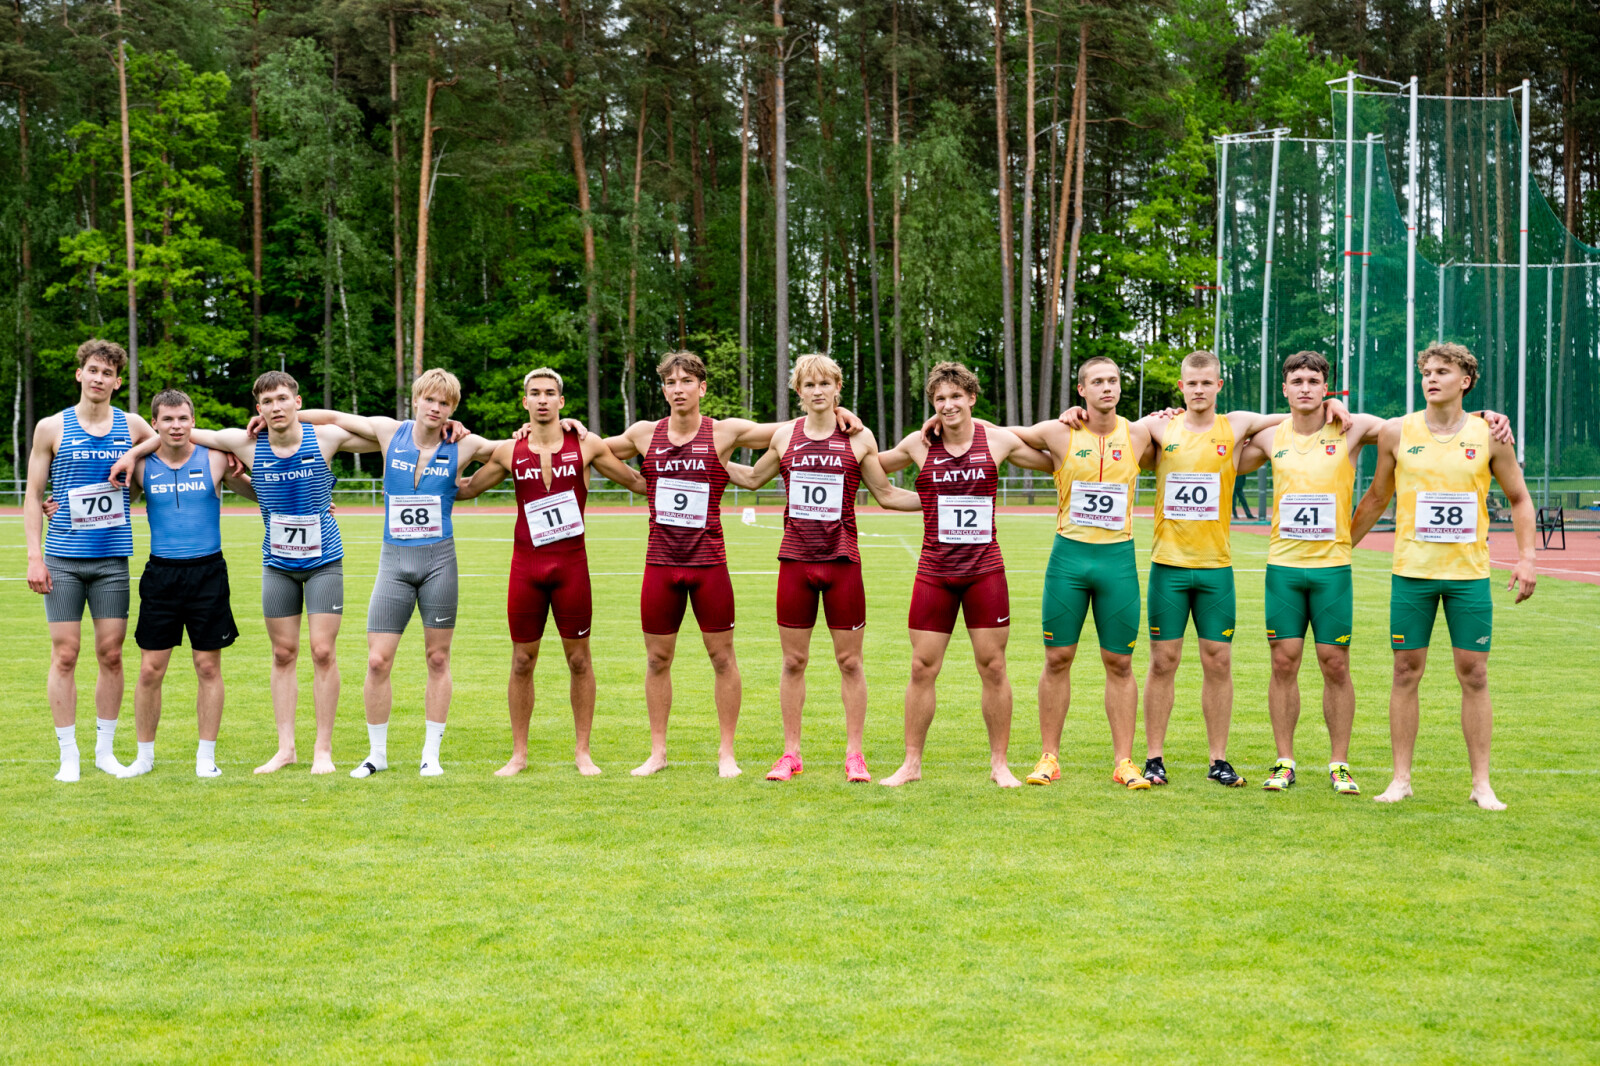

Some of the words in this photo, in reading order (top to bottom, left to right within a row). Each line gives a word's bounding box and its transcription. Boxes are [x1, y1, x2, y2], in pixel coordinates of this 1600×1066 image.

[391, 459, 449, 477] ESTONIA
[655, 459, 706, 471] LATVIA
[792, 455, 842, 467] LATVIA
[264, 469, 314, 481] ESTONIA
[515, 464, 576, 480] LATVIA
[932, 468, 986, 482] LATVIA
[151, 481, 206, 493] ESTONIA
[802, 485, 827, 504] 10
[1175, 486, 1207, 504] 40
[82, 496, 112, 515] 70
[674, 493, 688, 511] 9
[1083, 494, 1114, 513] 39
[400, 508, 429, 525] 68
[542, 508, 563, 527] 11
[954, 509, 977, 527] 12
[1294, 507, 1318, 525] 41
[1429, 506, 1463, 525] 38
[284, 527, 306, 544] 71
